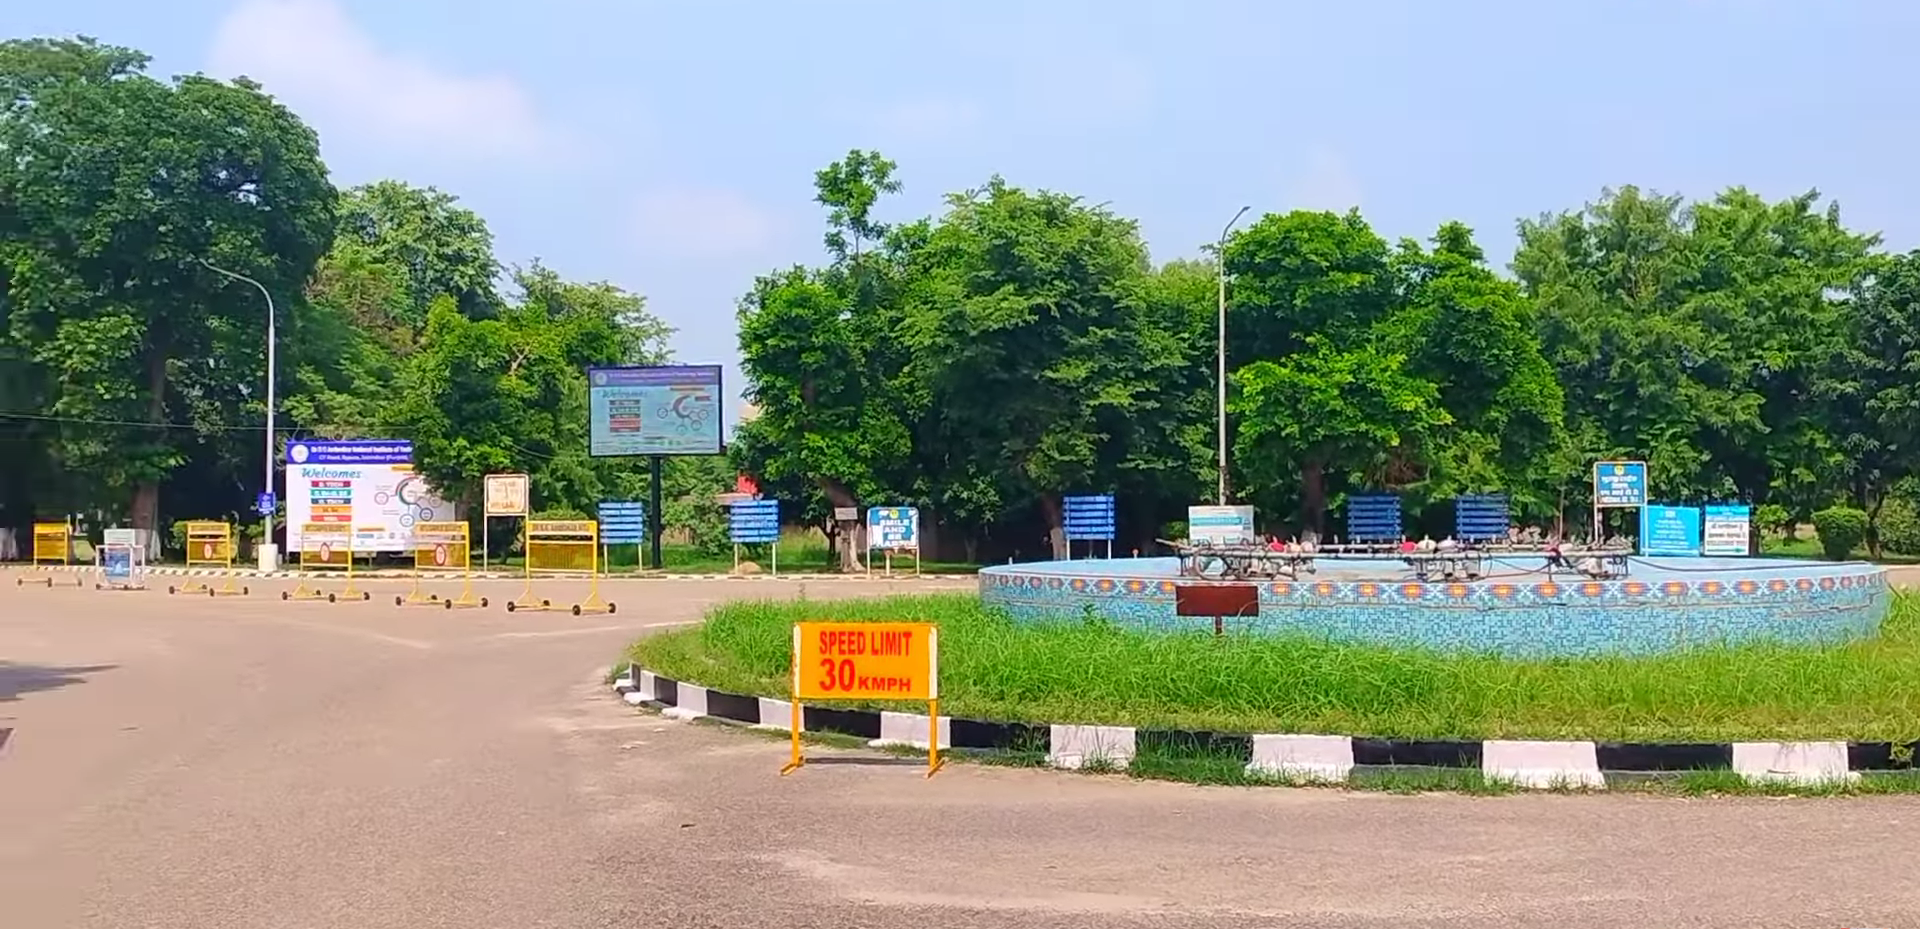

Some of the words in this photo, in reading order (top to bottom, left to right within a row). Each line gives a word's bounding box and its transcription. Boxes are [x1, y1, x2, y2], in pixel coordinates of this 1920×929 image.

[301, 467, 362, 478] Welcomes
[879, 518, 910, 526] SMILE
[819, 630, 866, 656] SPEED
[871, 631, 912, 657] LIMIT
[819, 658, 856, 692] 30
[858, 676, 911, 692] KMPH
